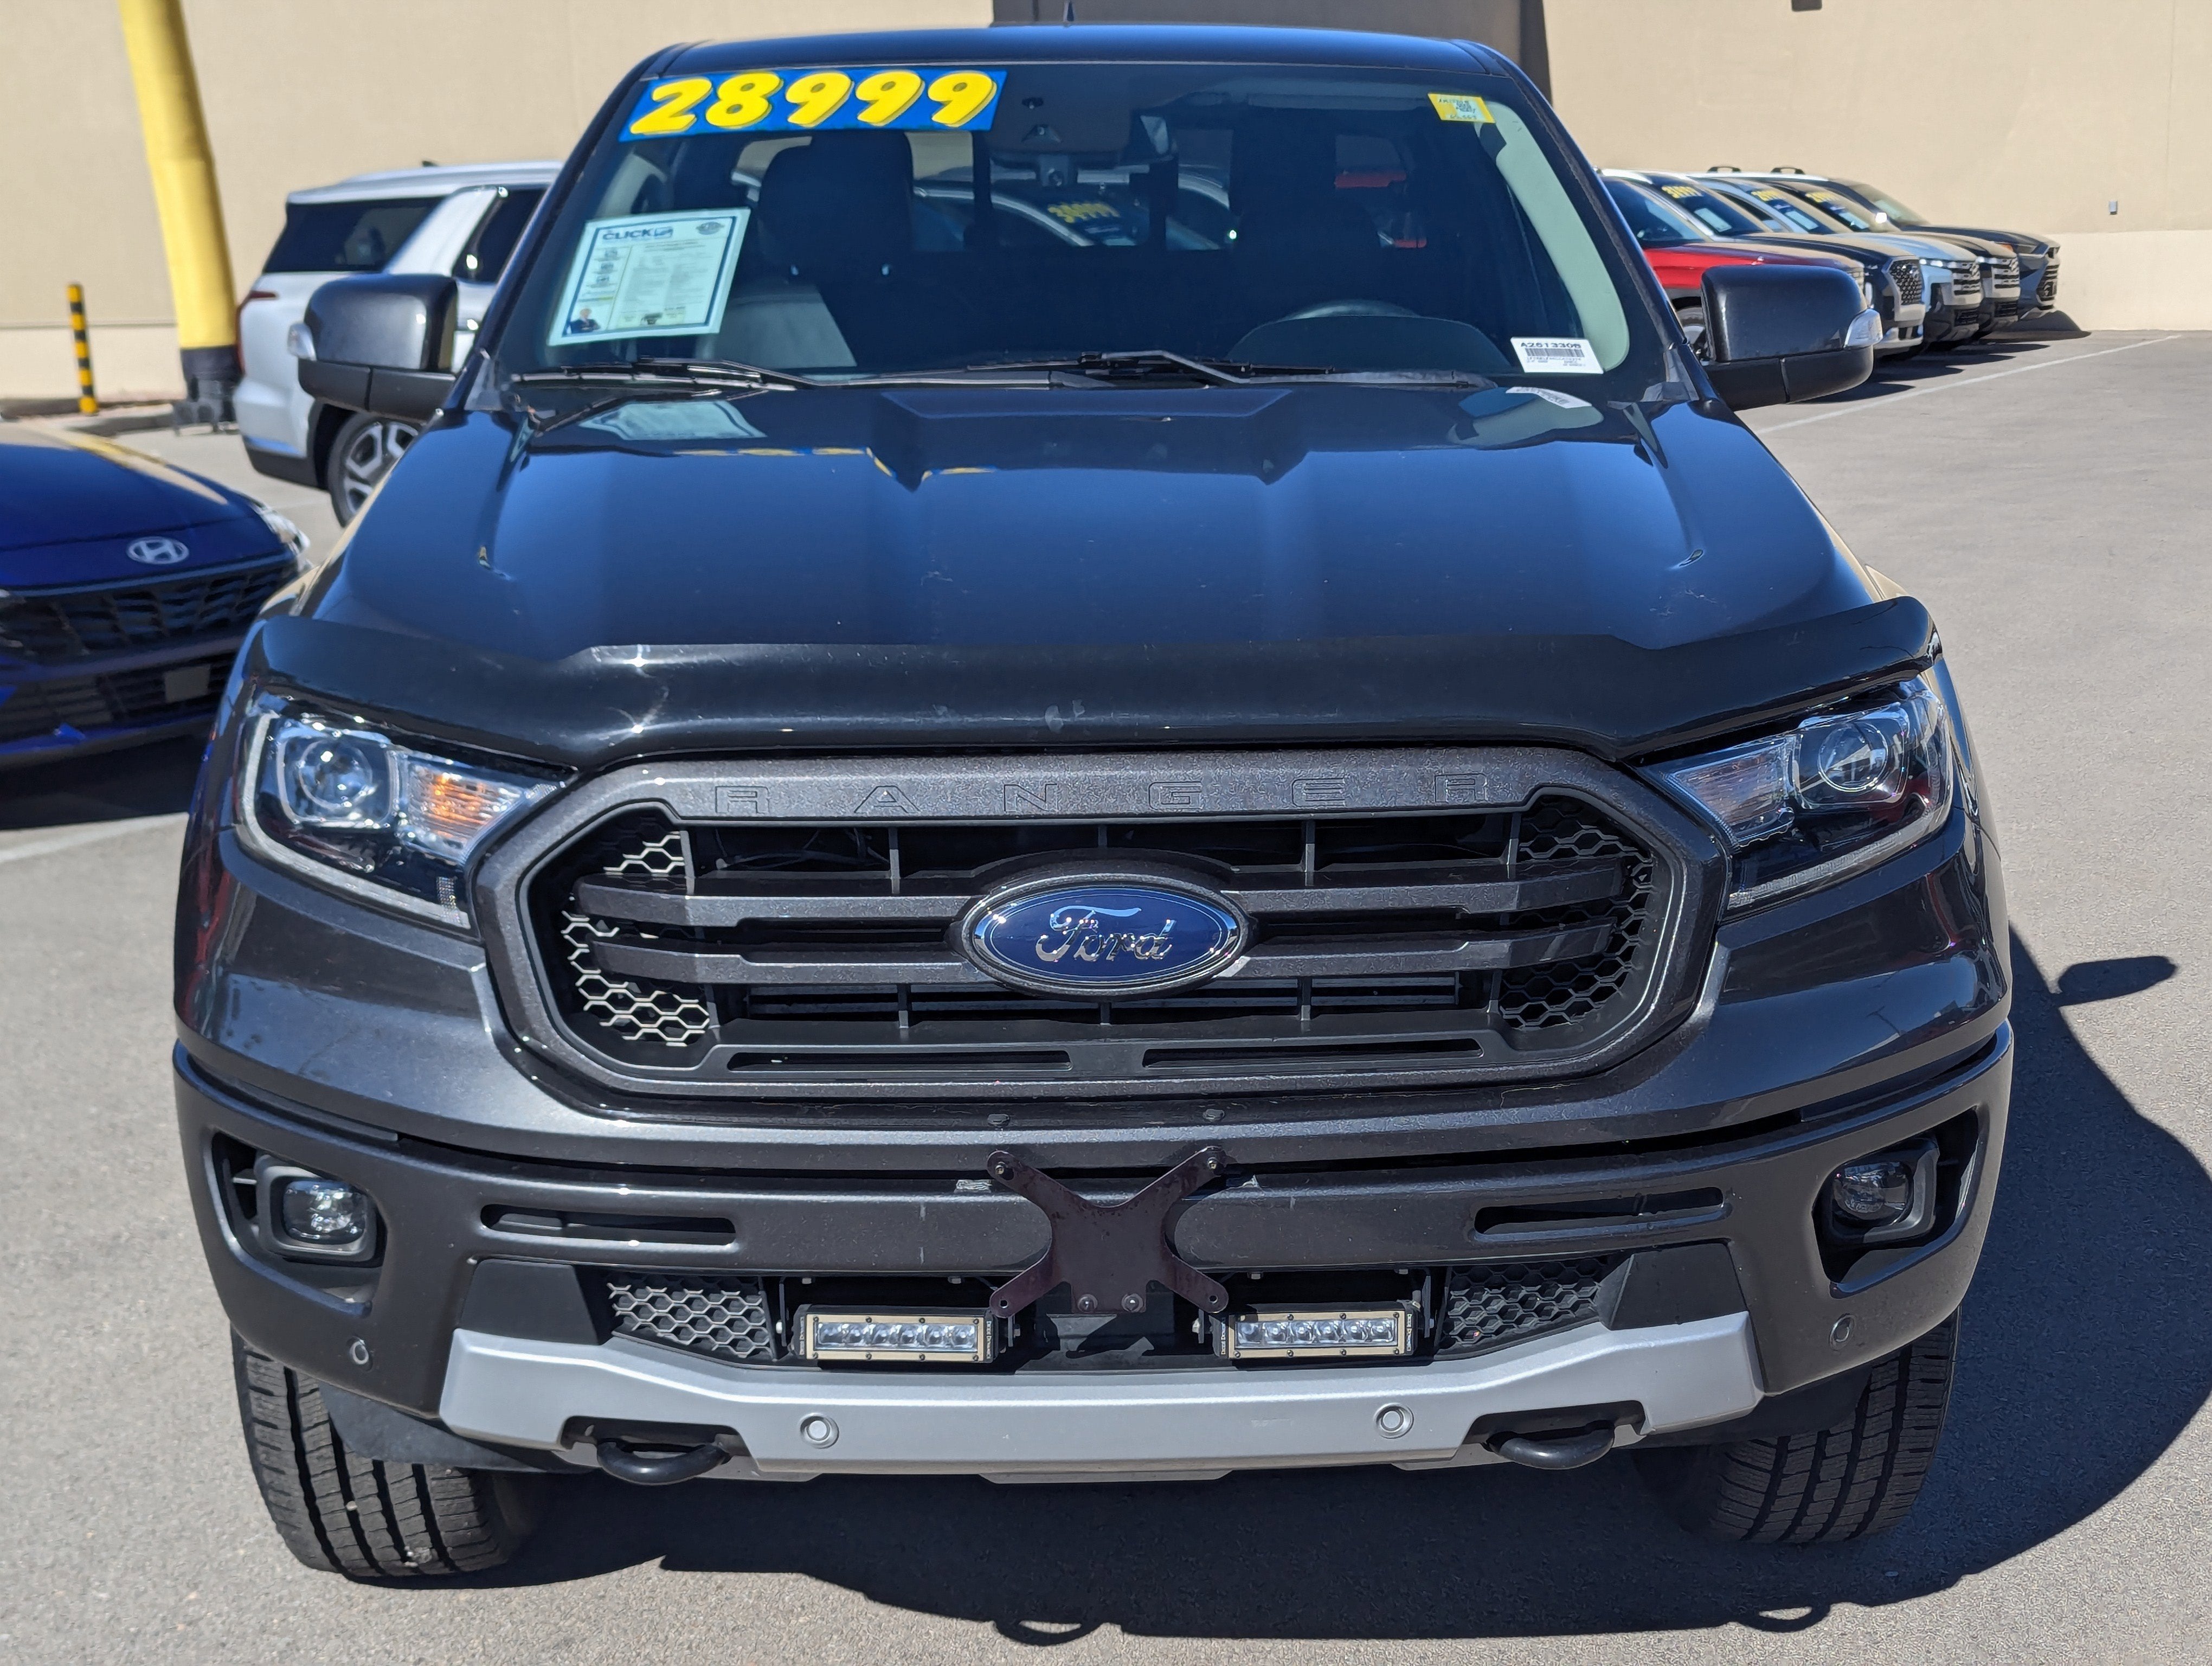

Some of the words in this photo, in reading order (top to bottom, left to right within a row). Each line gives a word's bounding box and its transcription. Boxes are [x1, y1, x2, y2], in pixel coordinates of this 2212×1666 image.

[630, 70, 996, 135] 28999
[715, 773, 1487, 814] RANGER
[1035, 905, 1176, 962] Ford
